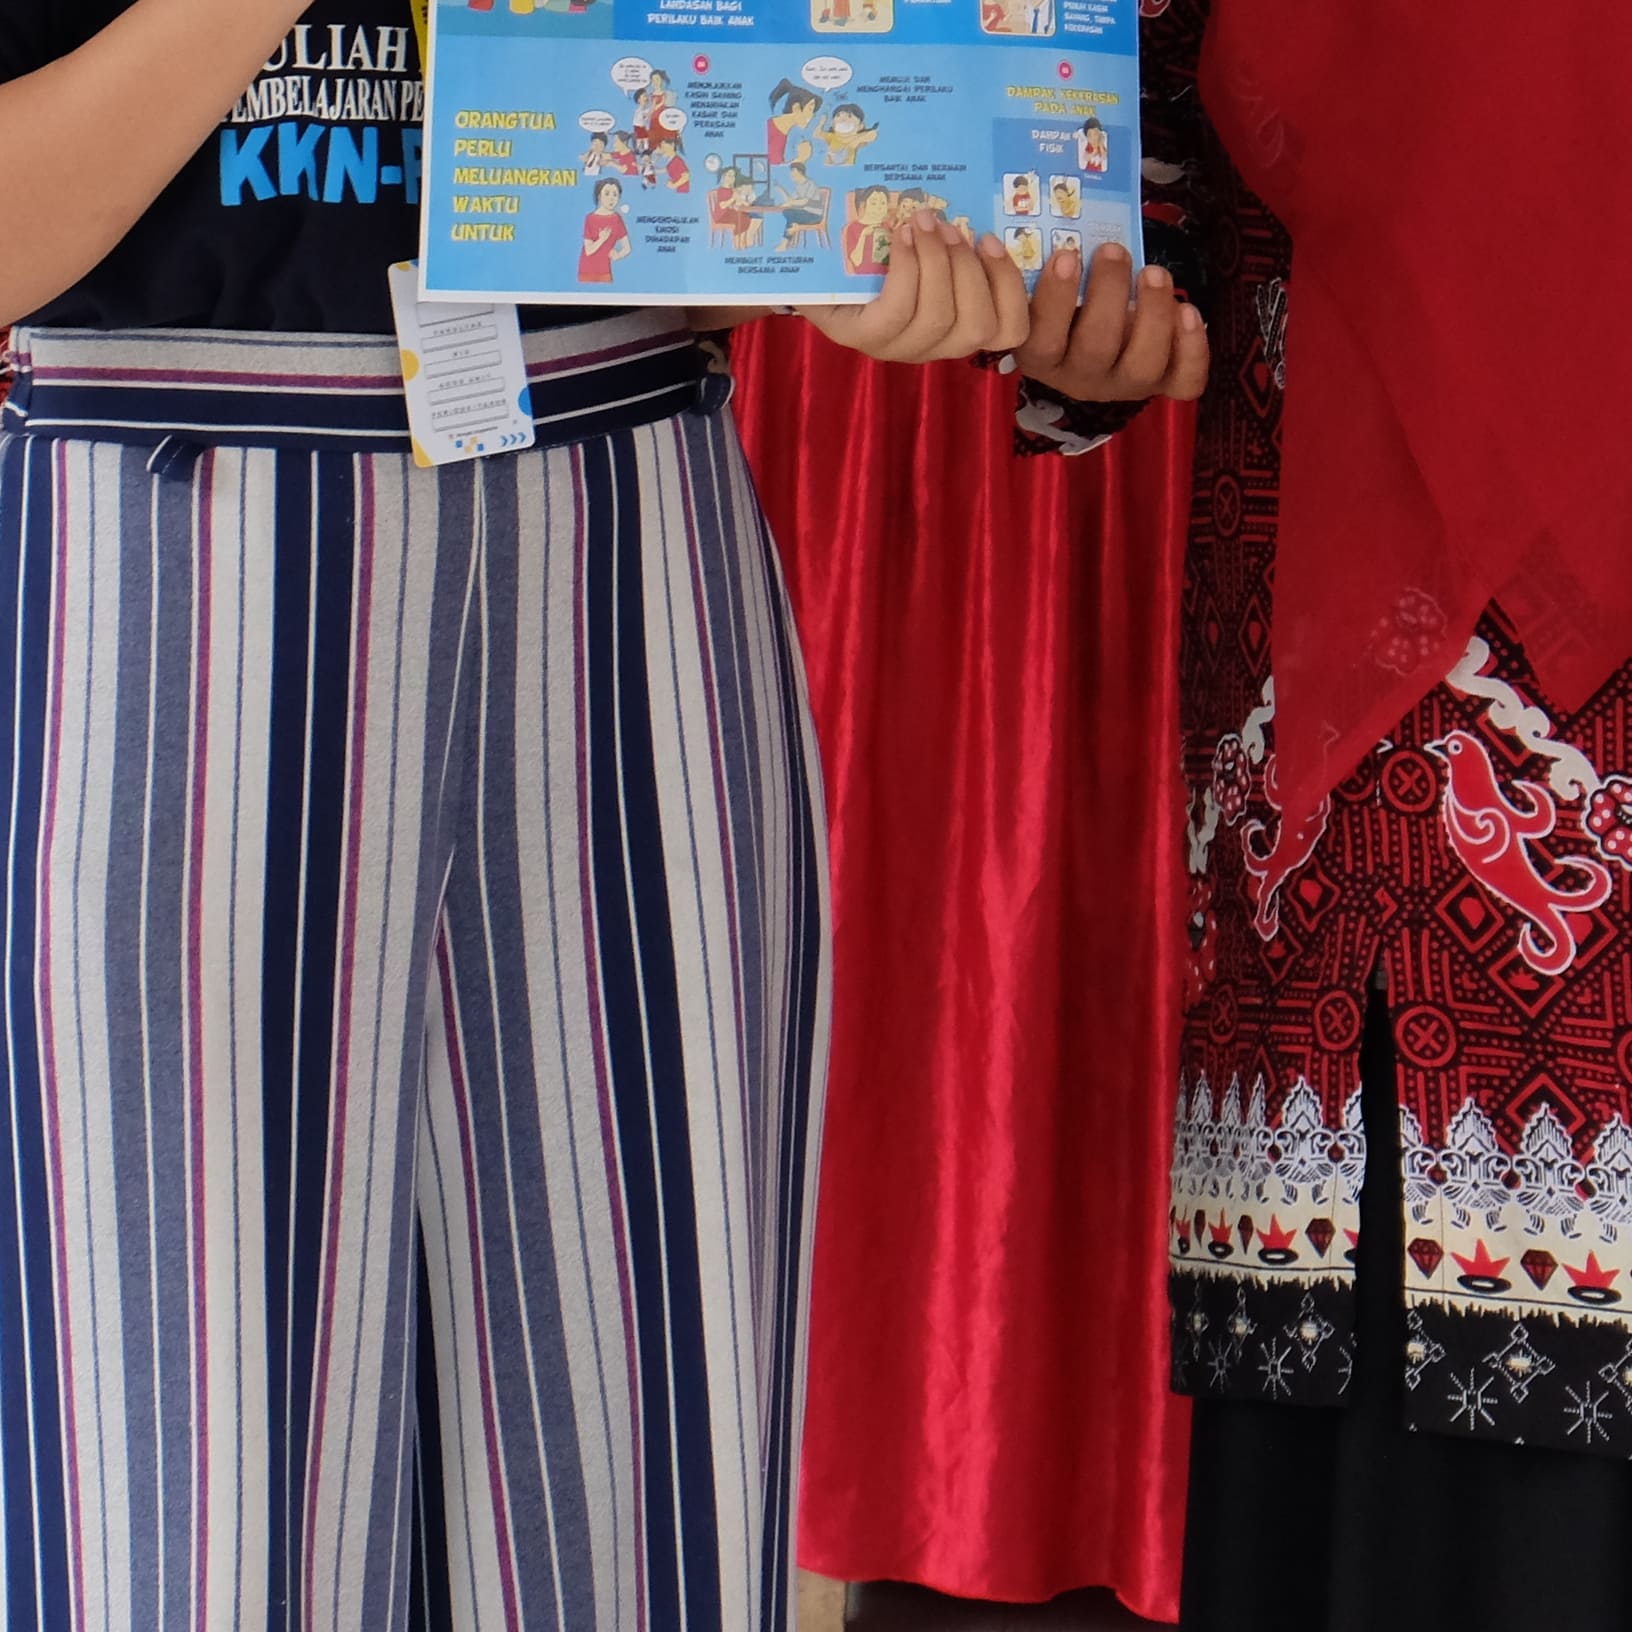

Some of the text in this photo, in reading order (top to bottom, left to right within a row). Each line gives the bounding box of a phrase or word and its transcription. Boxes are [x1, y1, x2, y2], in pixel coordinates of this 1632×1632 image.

[660, 0, 742, 11] LANDASAN BAGI
[647, 13, 754, 26] PERILAKU BAIK ANAK
[262, 24, 409, 72] ULIAH
[224, 75, 397, 123] EMBELAJARAN
[1007, 86, 1120, 105] DAMPAK KEKERASAN
[1034, 102, 1097, 117] PADA ANAK
[455, 110, 557, 130] ORANGTUA
[1031, 129, 1071, 141] DAMPAK
[454, 138, 513, 157] PERLU
[1039, 143, 1064, 154] FISIK
[219, 121, 423, 207] KKN-P
[454, 167, 577, 186] MELUANGKAN
[453, 195, 521, 214] WAKTU
[451, 223, 515, 242] UNTUK
